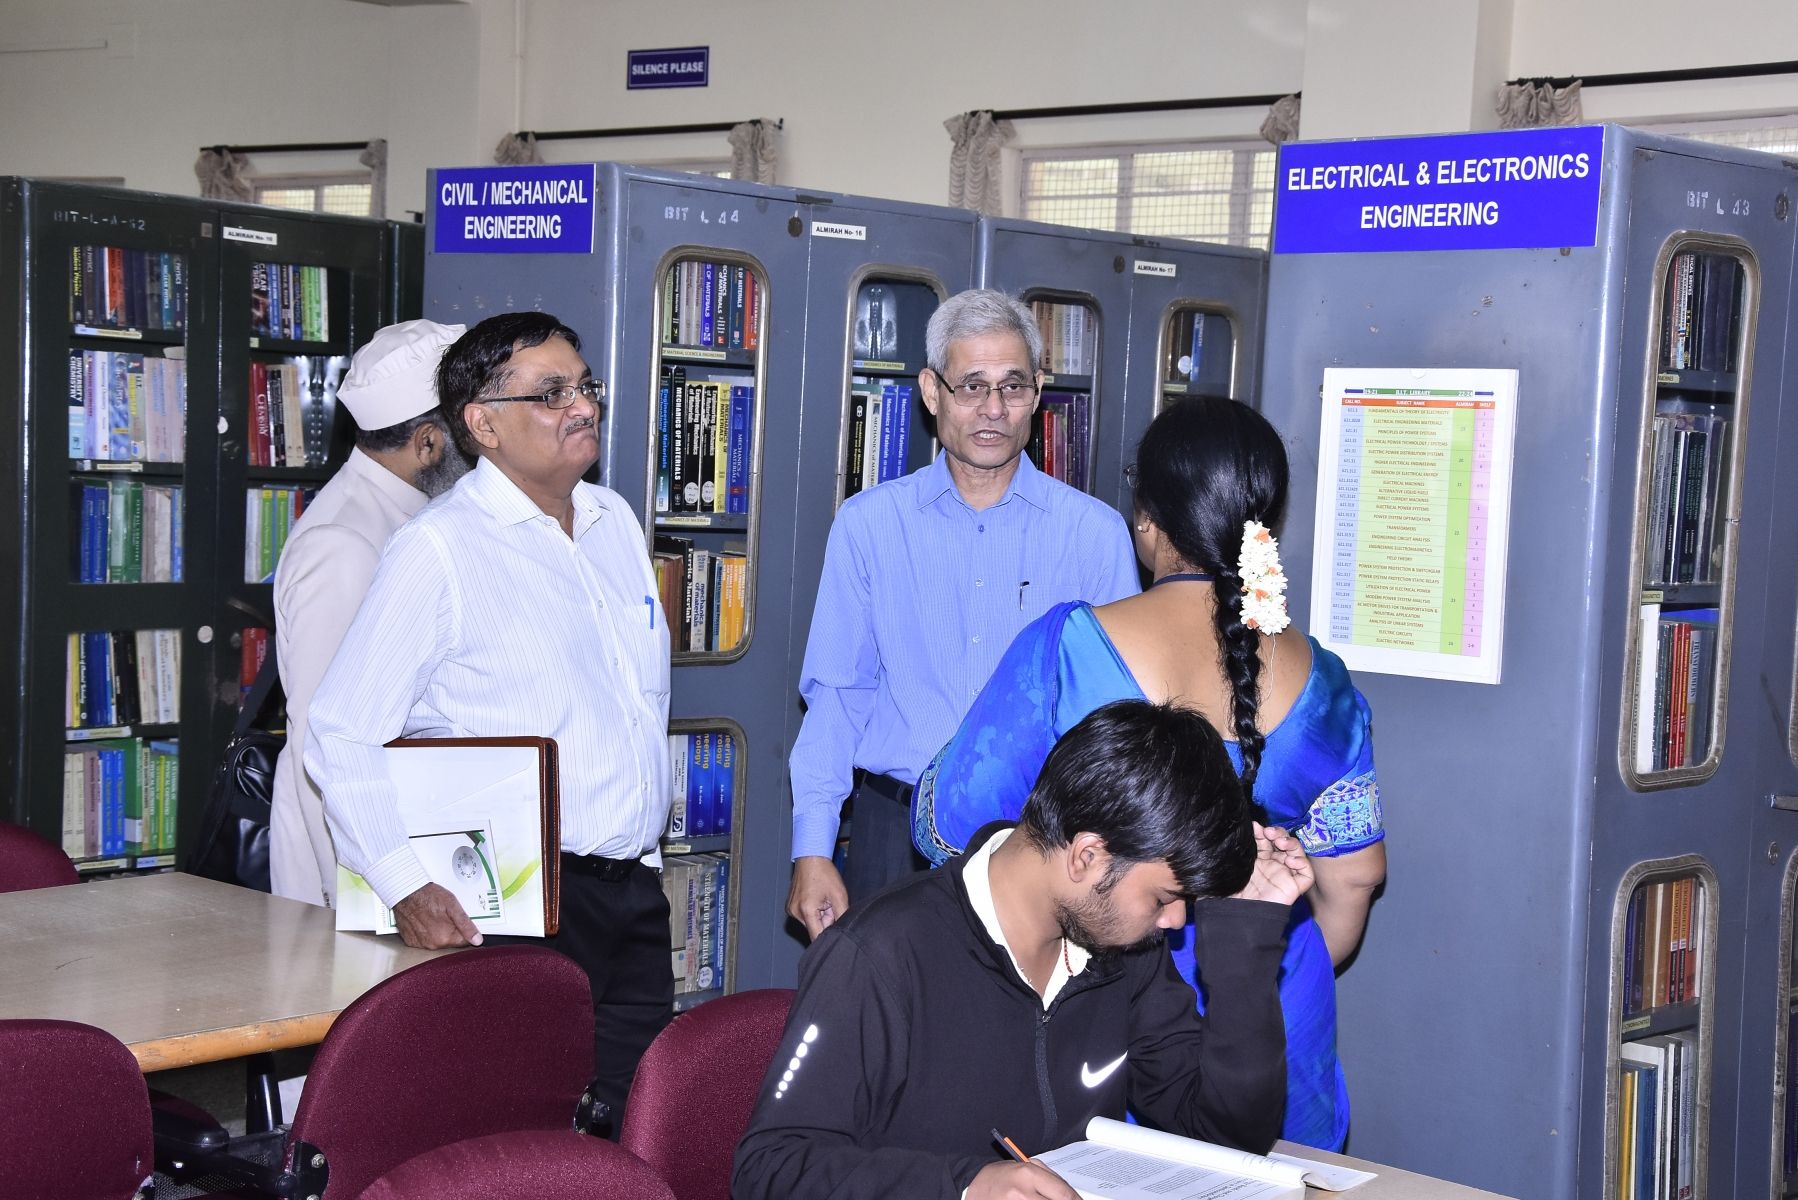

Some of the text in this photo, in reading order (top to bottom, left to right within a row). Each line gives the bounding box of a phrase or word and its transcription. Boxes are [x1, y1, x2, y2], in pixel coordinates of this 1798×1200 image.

[632, 61, 704, 75] SILENCE PLEASE
[1287, 153, 1589, 191] ELECTRICAL & ELECTRONICS
[441, 180, 587, 206] CIVIL / MECHANICAL
[464, 215, 562, 239] ENGINEERING
[664, 207, 688, 221] BIT
[1360, 201, 1499, 229] ENGINEERING
[228, 231, 254, 239] ALMIRAH
[816, 226, 843, 234] ALMIRAH
[706, 271, 711, 280] OF
[688, 388, 694, 397] of
[257, 393, 269, 437] CHEMISTRY
[710, 390, 718, 424] Engineering
[674, 387, 683, 480] MECHANICS OF MATERIALS
[692, 389, 702, 455] Engineering Mechanics
[695, 583, 700, 591] of
[1690, 640, 1701, 698] TRANSFORMERS
[694, 735, 702, 766] rology
[702, 733, 711, 769] neering
[703, 872, 711, 911] STRENGTH
[703, 912, 710, 922] OF
